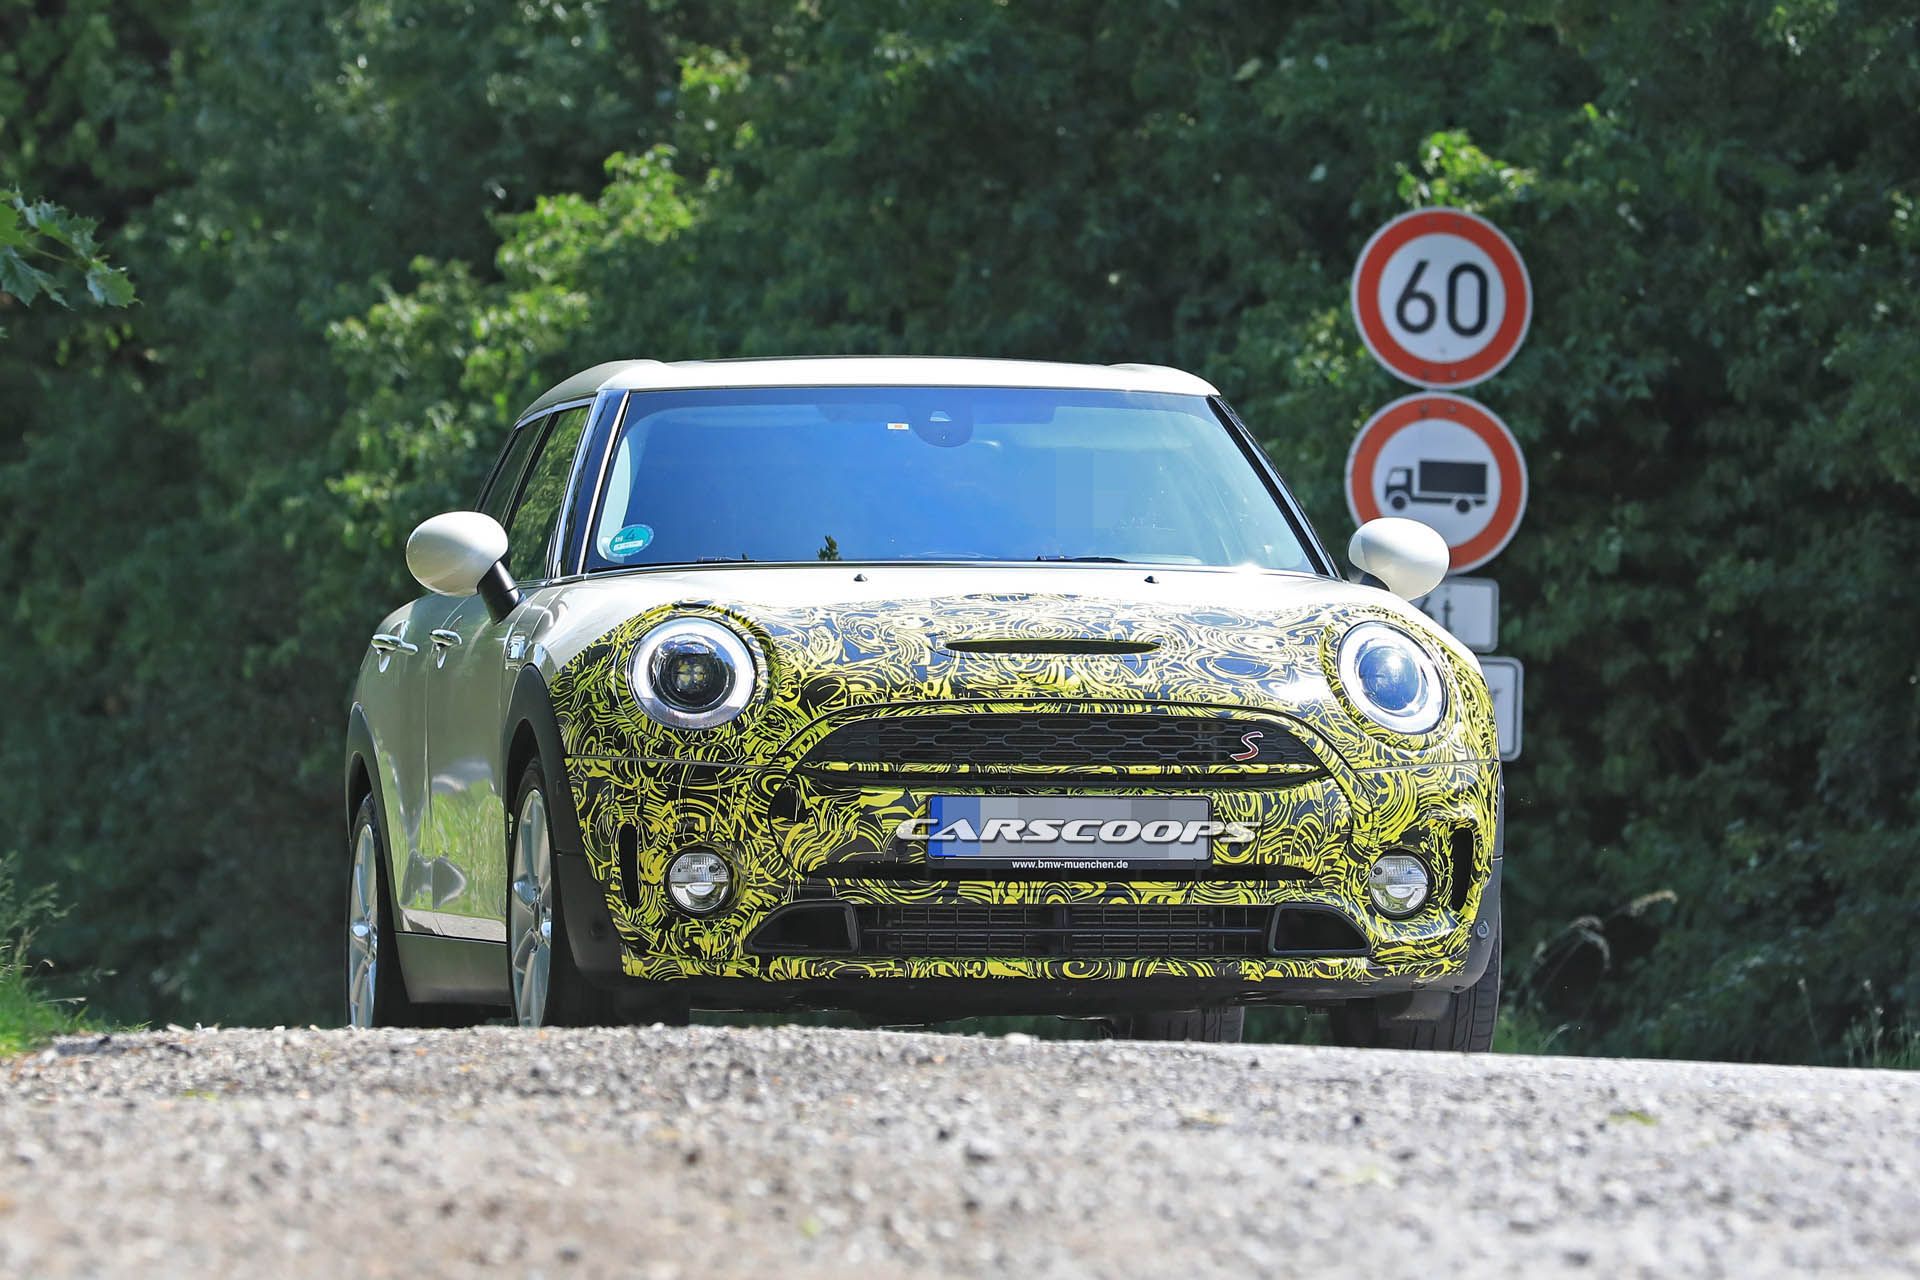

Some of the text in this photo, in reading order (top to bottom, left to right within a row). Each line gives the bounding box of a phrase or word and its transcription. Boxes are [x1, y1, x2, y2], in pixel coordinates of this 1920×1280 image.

[1396, 259, 1488, 337] 60
[1230, 731, 1263, 761] S
[1011, 859, 1129, 869] www.bmw-muenchen.de
